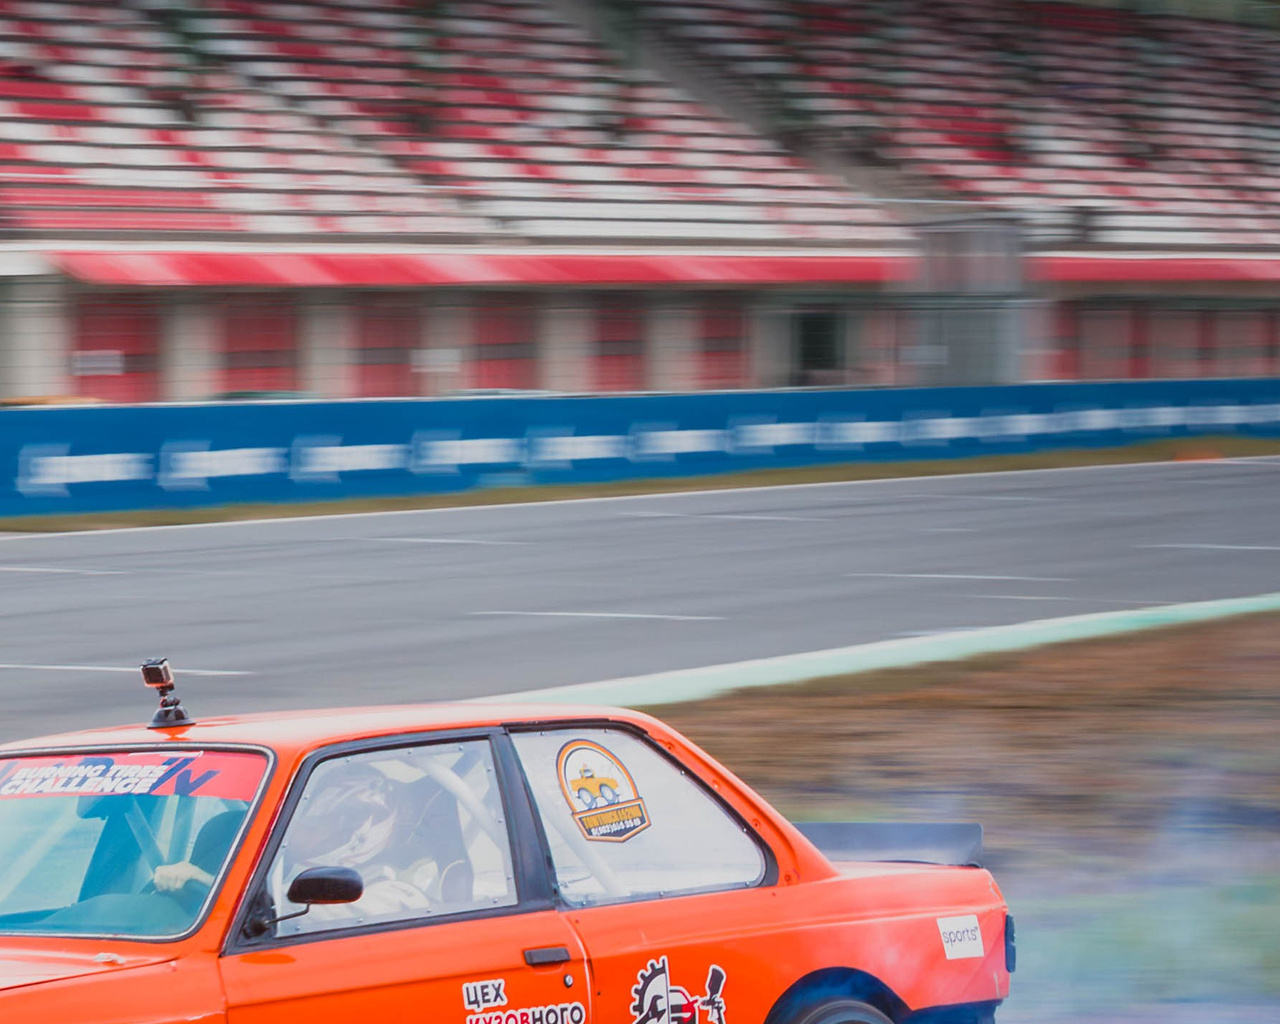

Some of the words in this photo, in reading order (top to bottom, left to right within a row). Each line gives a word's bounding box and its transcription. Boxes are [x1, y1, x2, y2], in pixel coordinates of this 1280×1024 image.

[13, 764, 107, 780] BURNING
[107, 764, 168, 779] TIRES
[0, 776, 160, 795] CHALLENGE
[464, 981, 505, 1009] ЦЕХ
